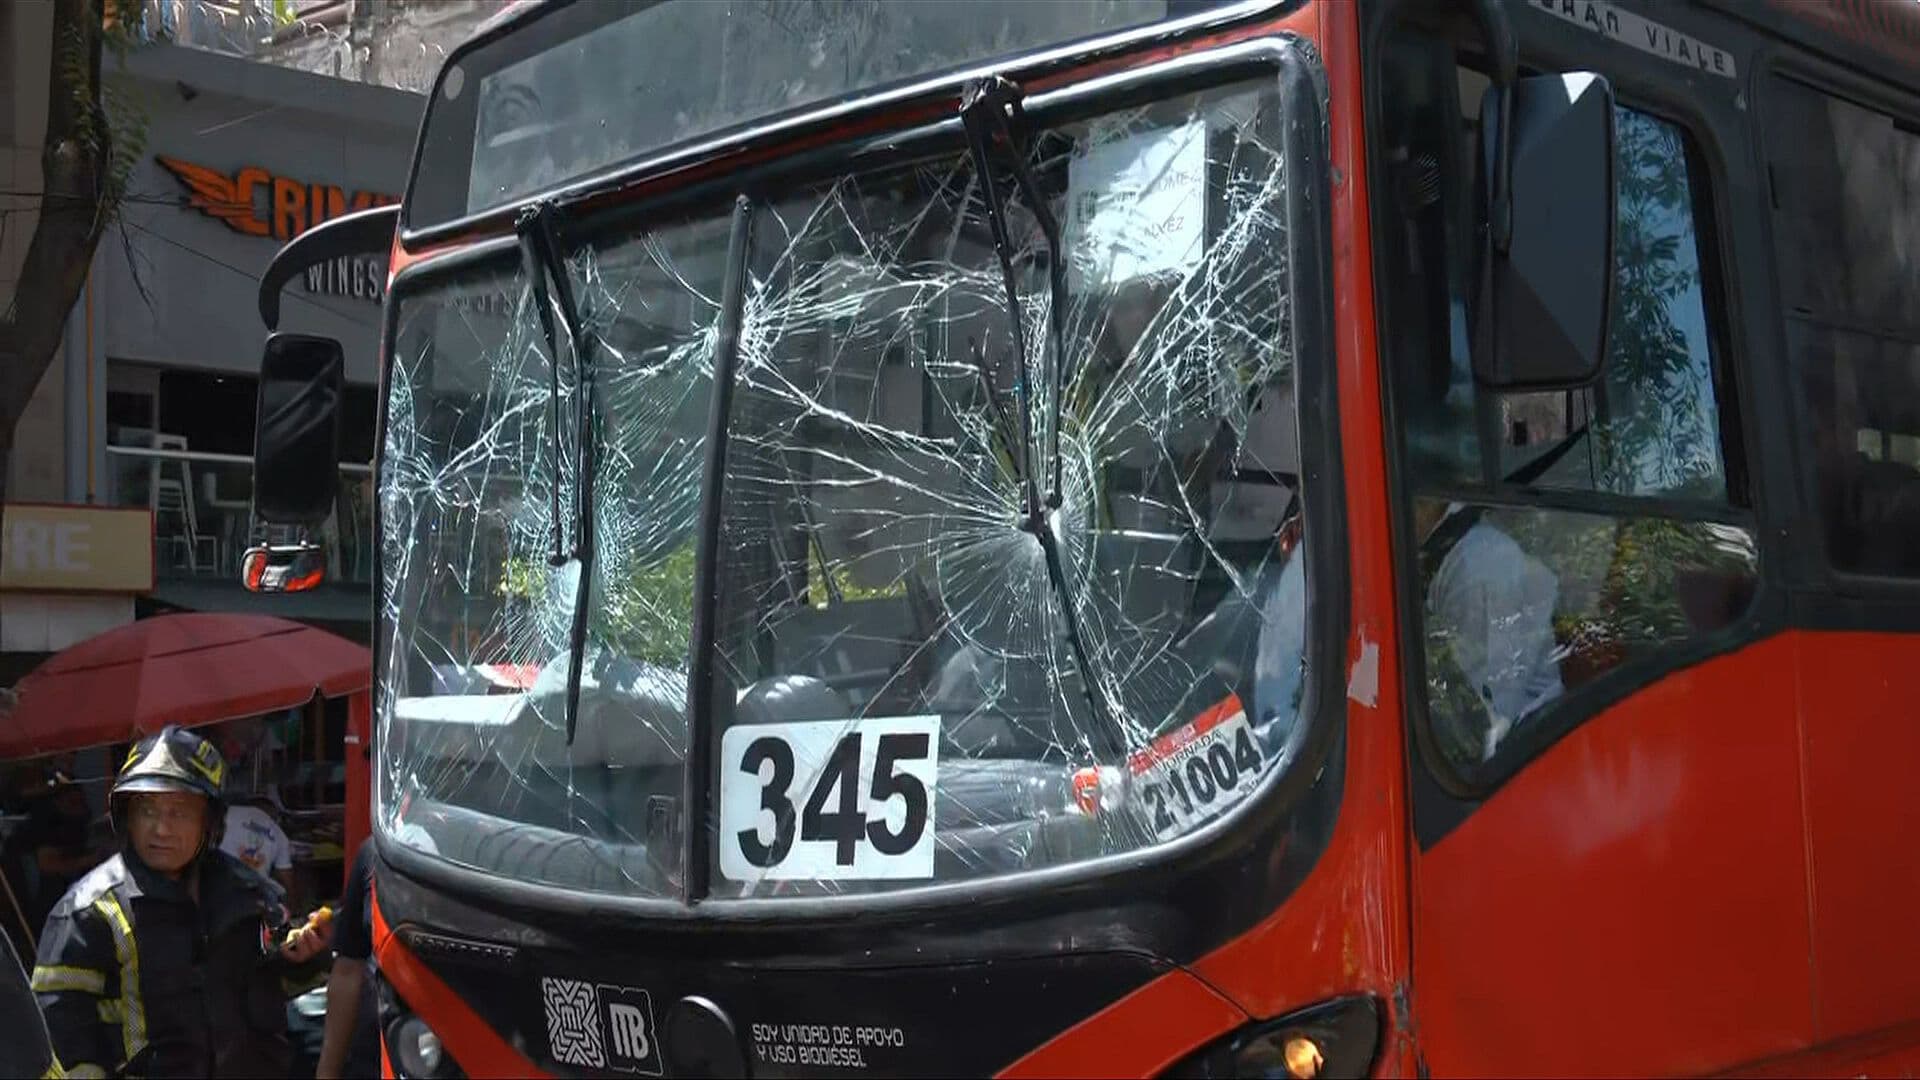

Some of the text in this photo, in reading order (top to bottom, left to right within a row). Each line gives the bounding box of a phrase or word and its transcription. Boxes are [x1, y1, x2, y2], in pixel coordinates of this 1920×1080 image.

[1645, 25, 1725, 71] VIALE
[13, 520, 91, 571] RE
[737, 731, 930, 869] 345
[1143, 726, 1262, 834] 21004
[752, 1024, 904, 1047] SOY UNIDAD DE APOYO
[757, 1045, 766, 1061] Y
[769, 1046, 796, 1063] USO
